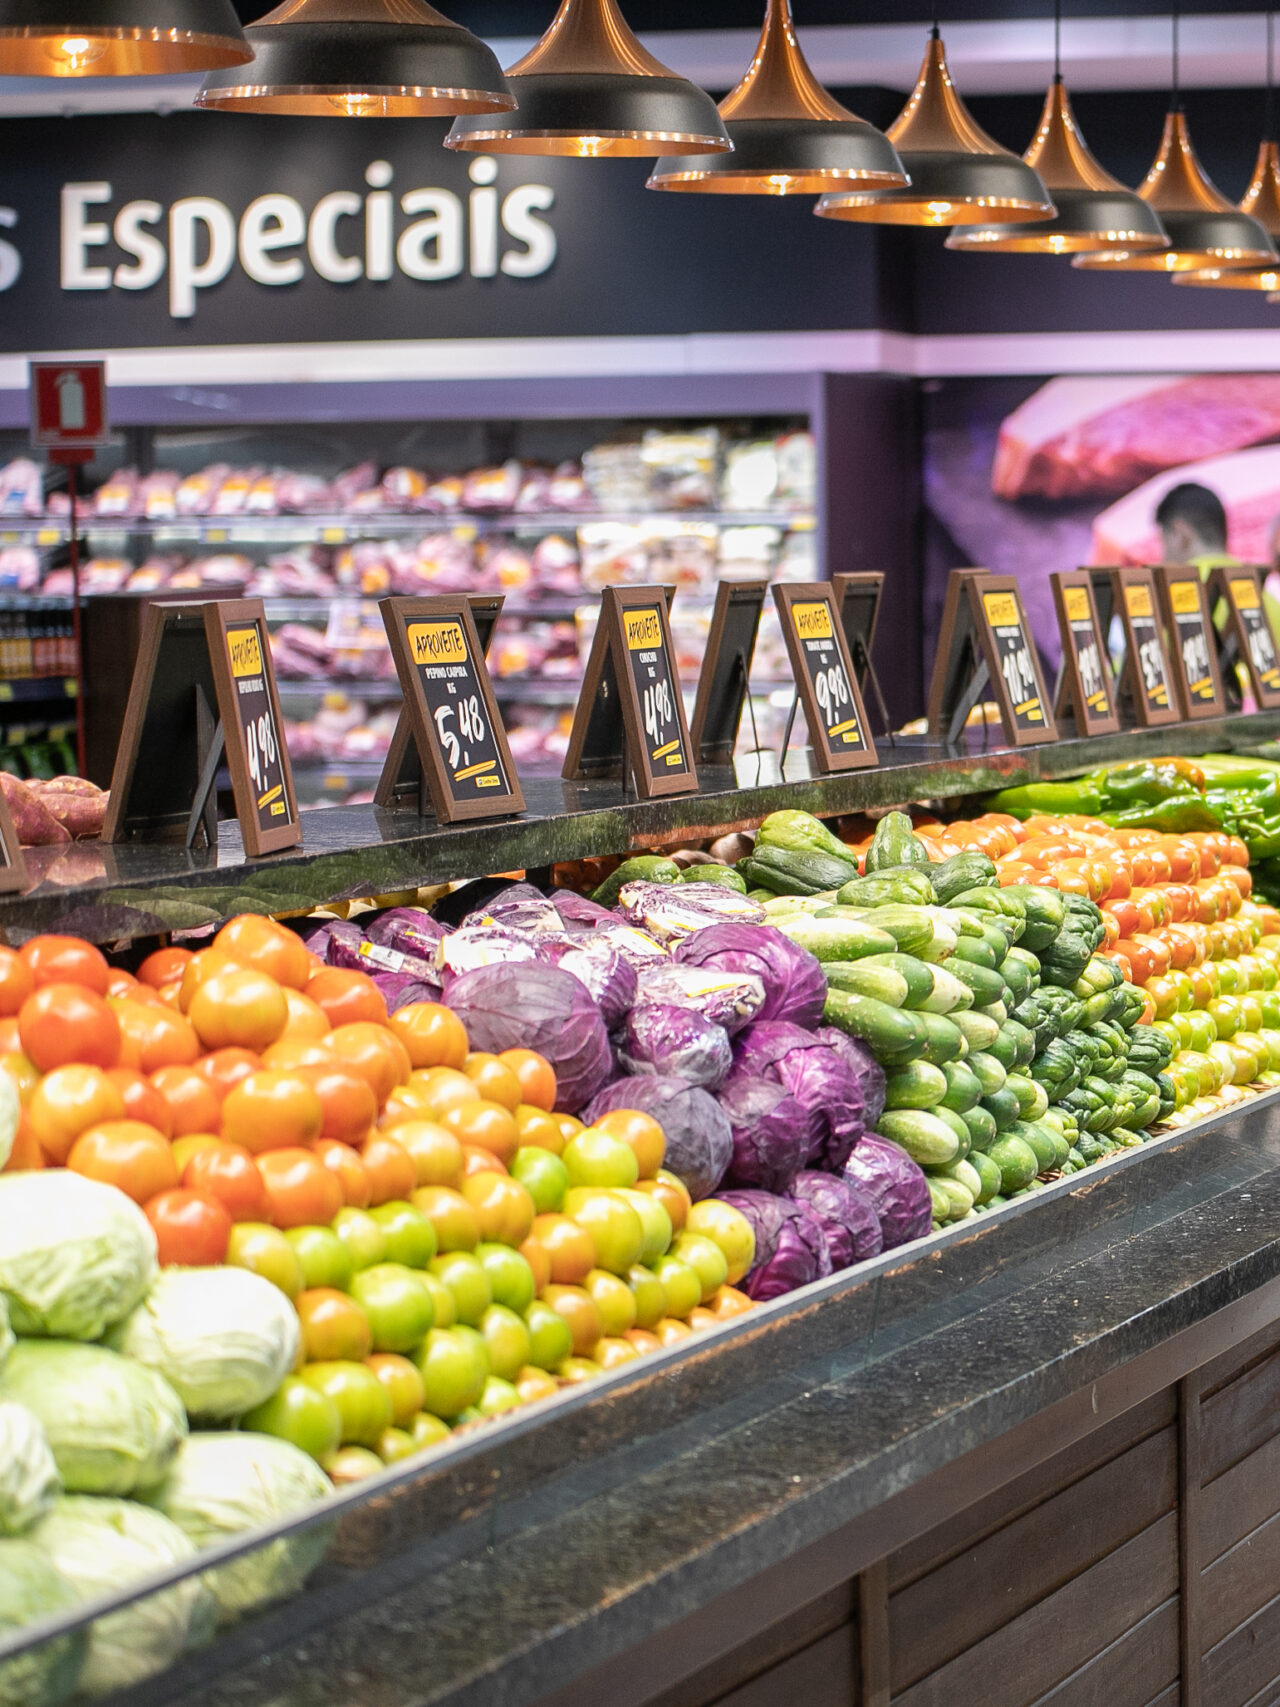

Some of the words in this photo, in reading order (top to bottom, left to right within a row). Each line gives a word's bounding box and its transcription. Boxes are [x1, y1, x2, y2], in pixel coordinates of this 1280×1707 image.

[61, 155, 557, 317] Especiais
[416, 628, 462, 660] APROVEITE
[628, 615, 660, 645] APROVEITE
[425, 666, 446, 679] PEPINO
[446, 665, 468, 678] CAIPIRA
[446, 682, 457, 694] KG
[815, 664, 848, 726] 9,98
[433, 694, 485, 770] 5,48
[644, 678, 672, 745] 4,98
[246, 710, 276, 792] 4,98
